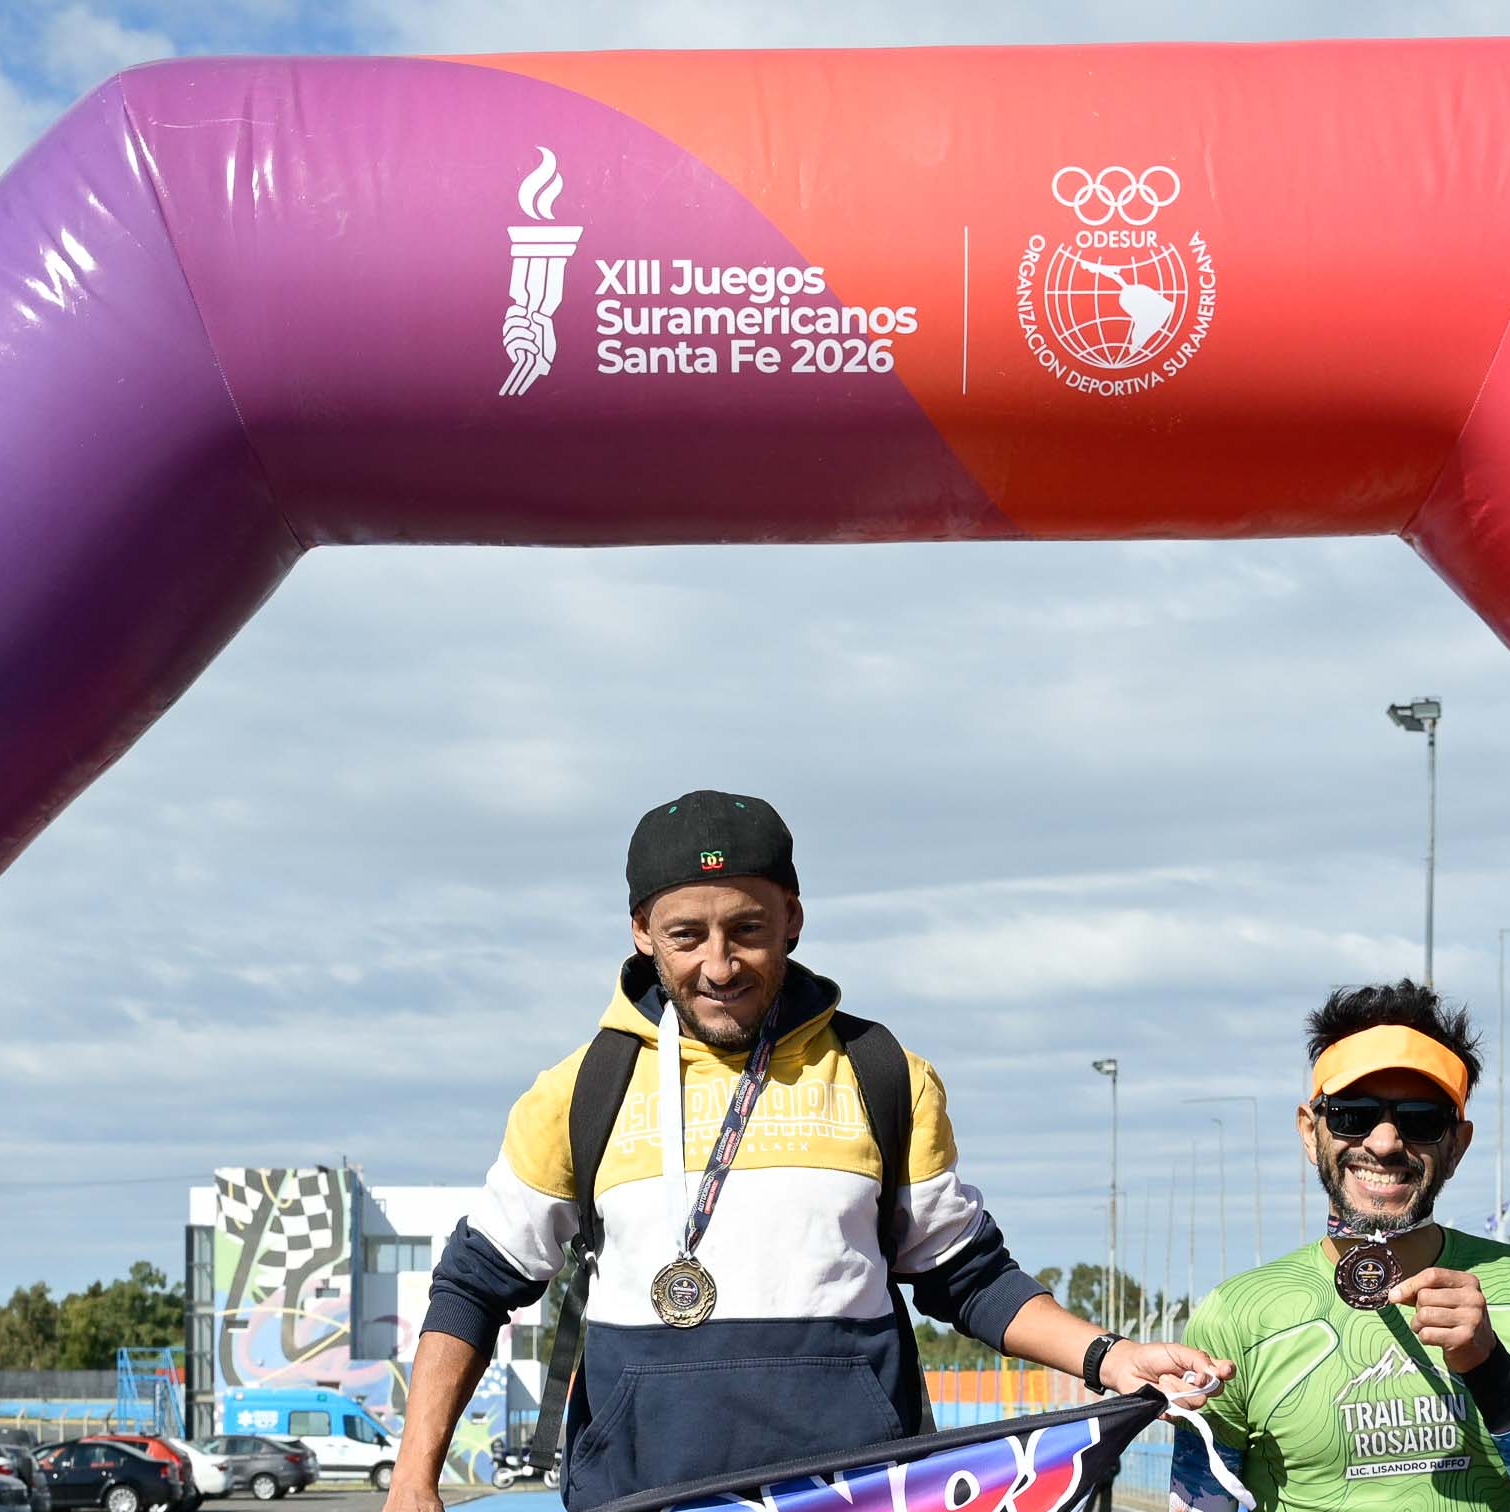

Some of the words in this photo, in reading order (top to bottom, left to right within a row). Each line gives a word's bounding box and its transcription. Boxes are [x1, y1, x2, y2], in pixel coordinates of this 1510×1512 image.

[1075, 229, 1158, 249] ODESUR
[594, 258, 661, 296] XIII
[669, 258, 826, 304] Juegos
[595, 296, 919, 336] Suramericanos
[1016, 234, 1068, 380] ORGANIZACION
[1065, 370, 1165, 397] DEPORTIVA
[1162, 230, 1217, 378] SURAMERICANA
[596, 339, 718, 375] Santa
[730, 339, 782, 374] Fe
[790, 338, 895, 375] 2026
[1340, 1398, 1413, 1433] TRAIL
[1413, 1393, 1467, 1427] RUN
[1354, 1424, 1457, 1458] ROSARIO
[1350, 1467, 1370, 1477] LIC.
[1372, 1461, 1427, 1475] LISANDRO
[1430, 1458, 1466, 1470] RUFFO
